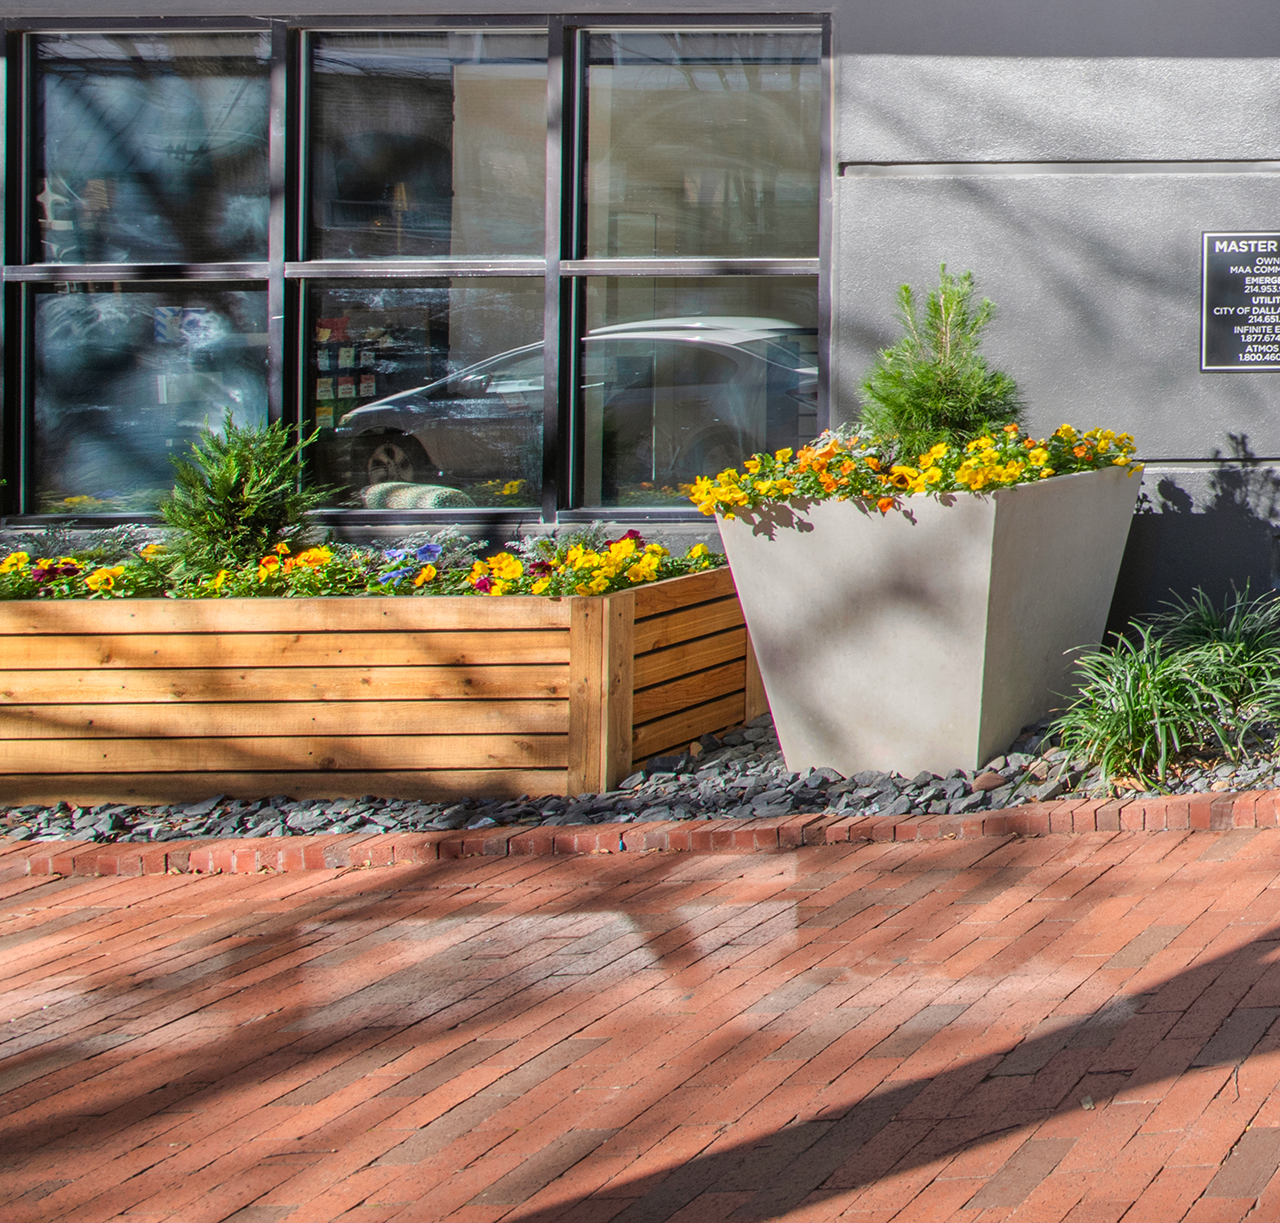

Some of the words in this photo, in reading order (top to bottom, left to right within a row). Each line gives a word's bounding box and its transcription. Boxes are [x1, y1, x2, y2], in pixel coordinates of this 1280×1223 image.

[1214, 240, 1278, 253] MASTER
[1229, 266, 1252, 274] MAA
[1213, 307, 1235, 315] CITY
[1236, 307, 1250, 315] OF
[1233, 325, 1273, 334] INFINITE
[1245, 344, 1279, 353] ATMOS
